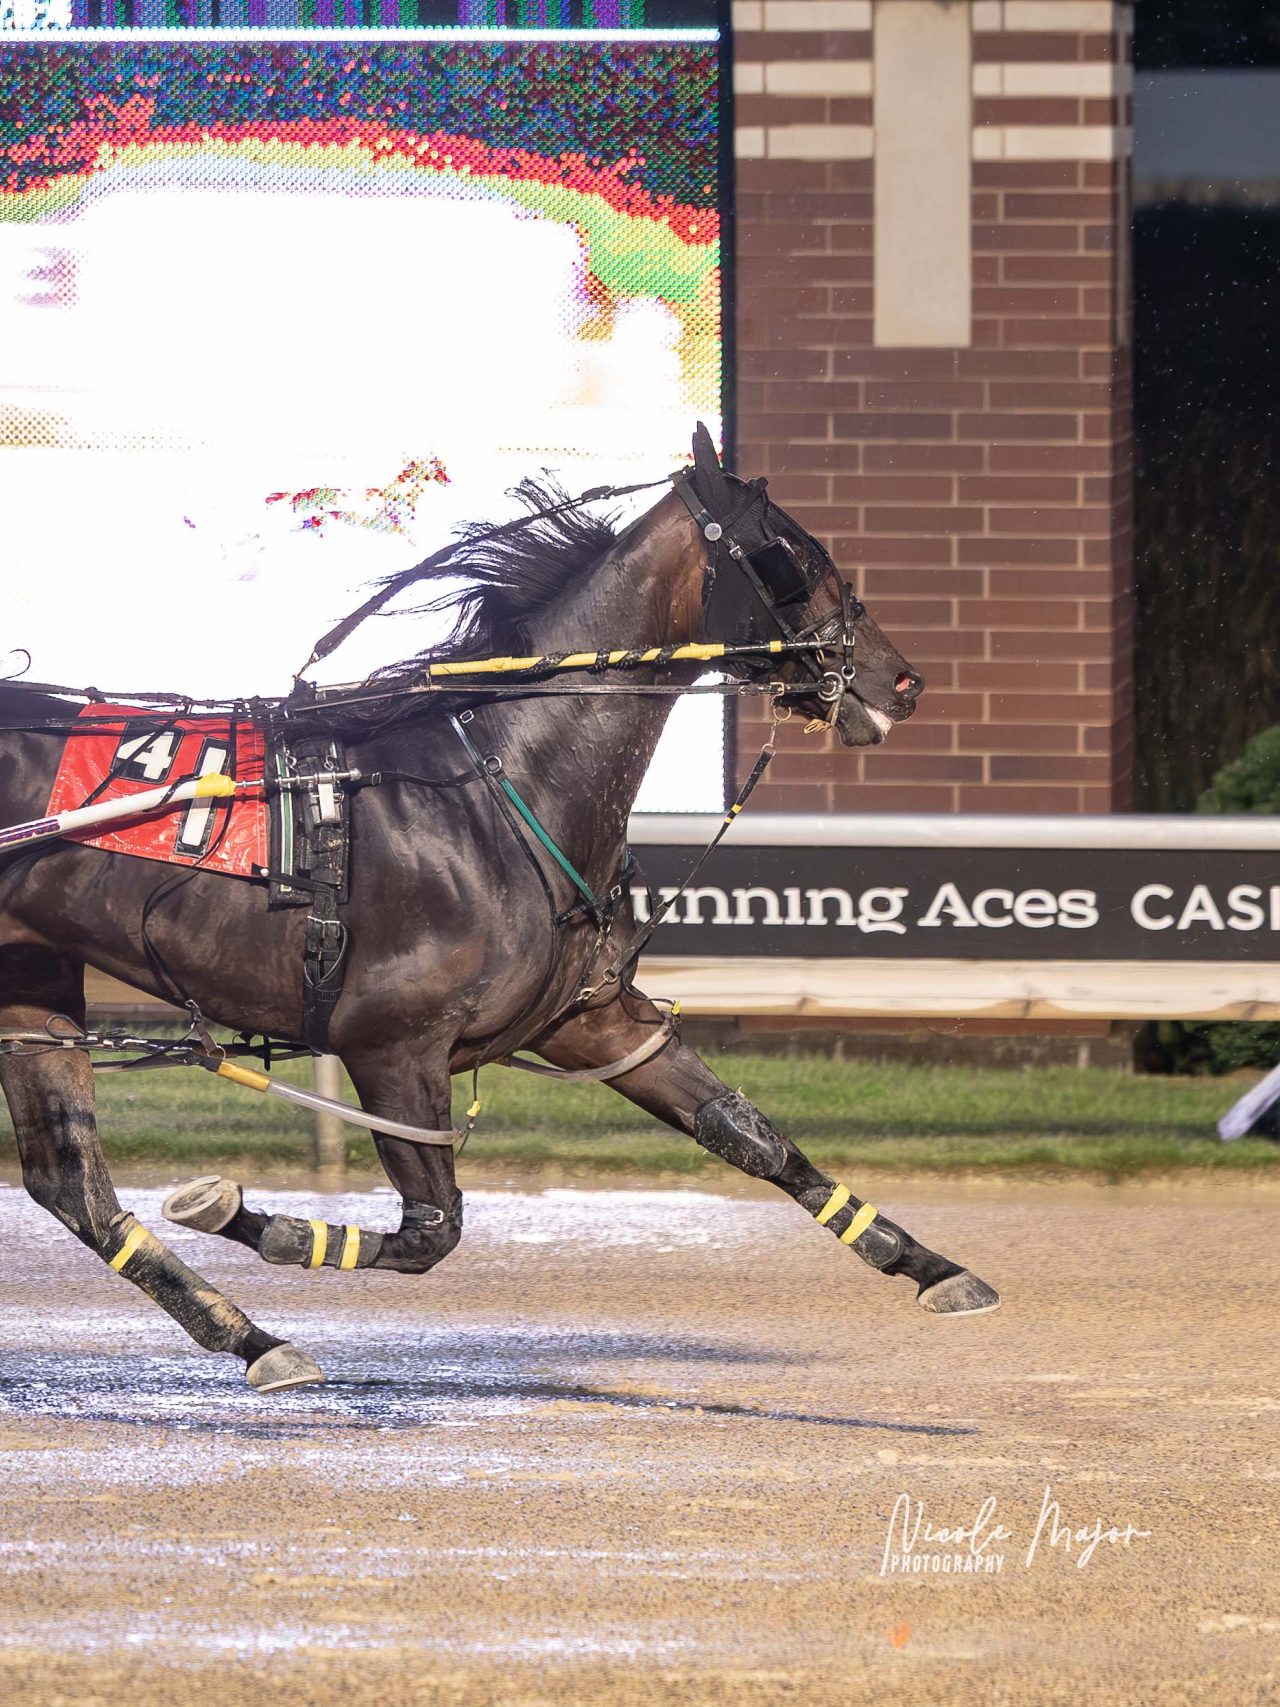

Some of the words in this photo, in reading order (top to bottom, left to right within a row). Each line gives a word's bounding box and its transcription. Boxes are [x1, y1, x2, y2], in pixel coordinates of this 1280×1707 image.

[117, 731, 175, 780] 4
[630, 886, 909, 935] unning
[917, 882, 1099, 928] Aces
